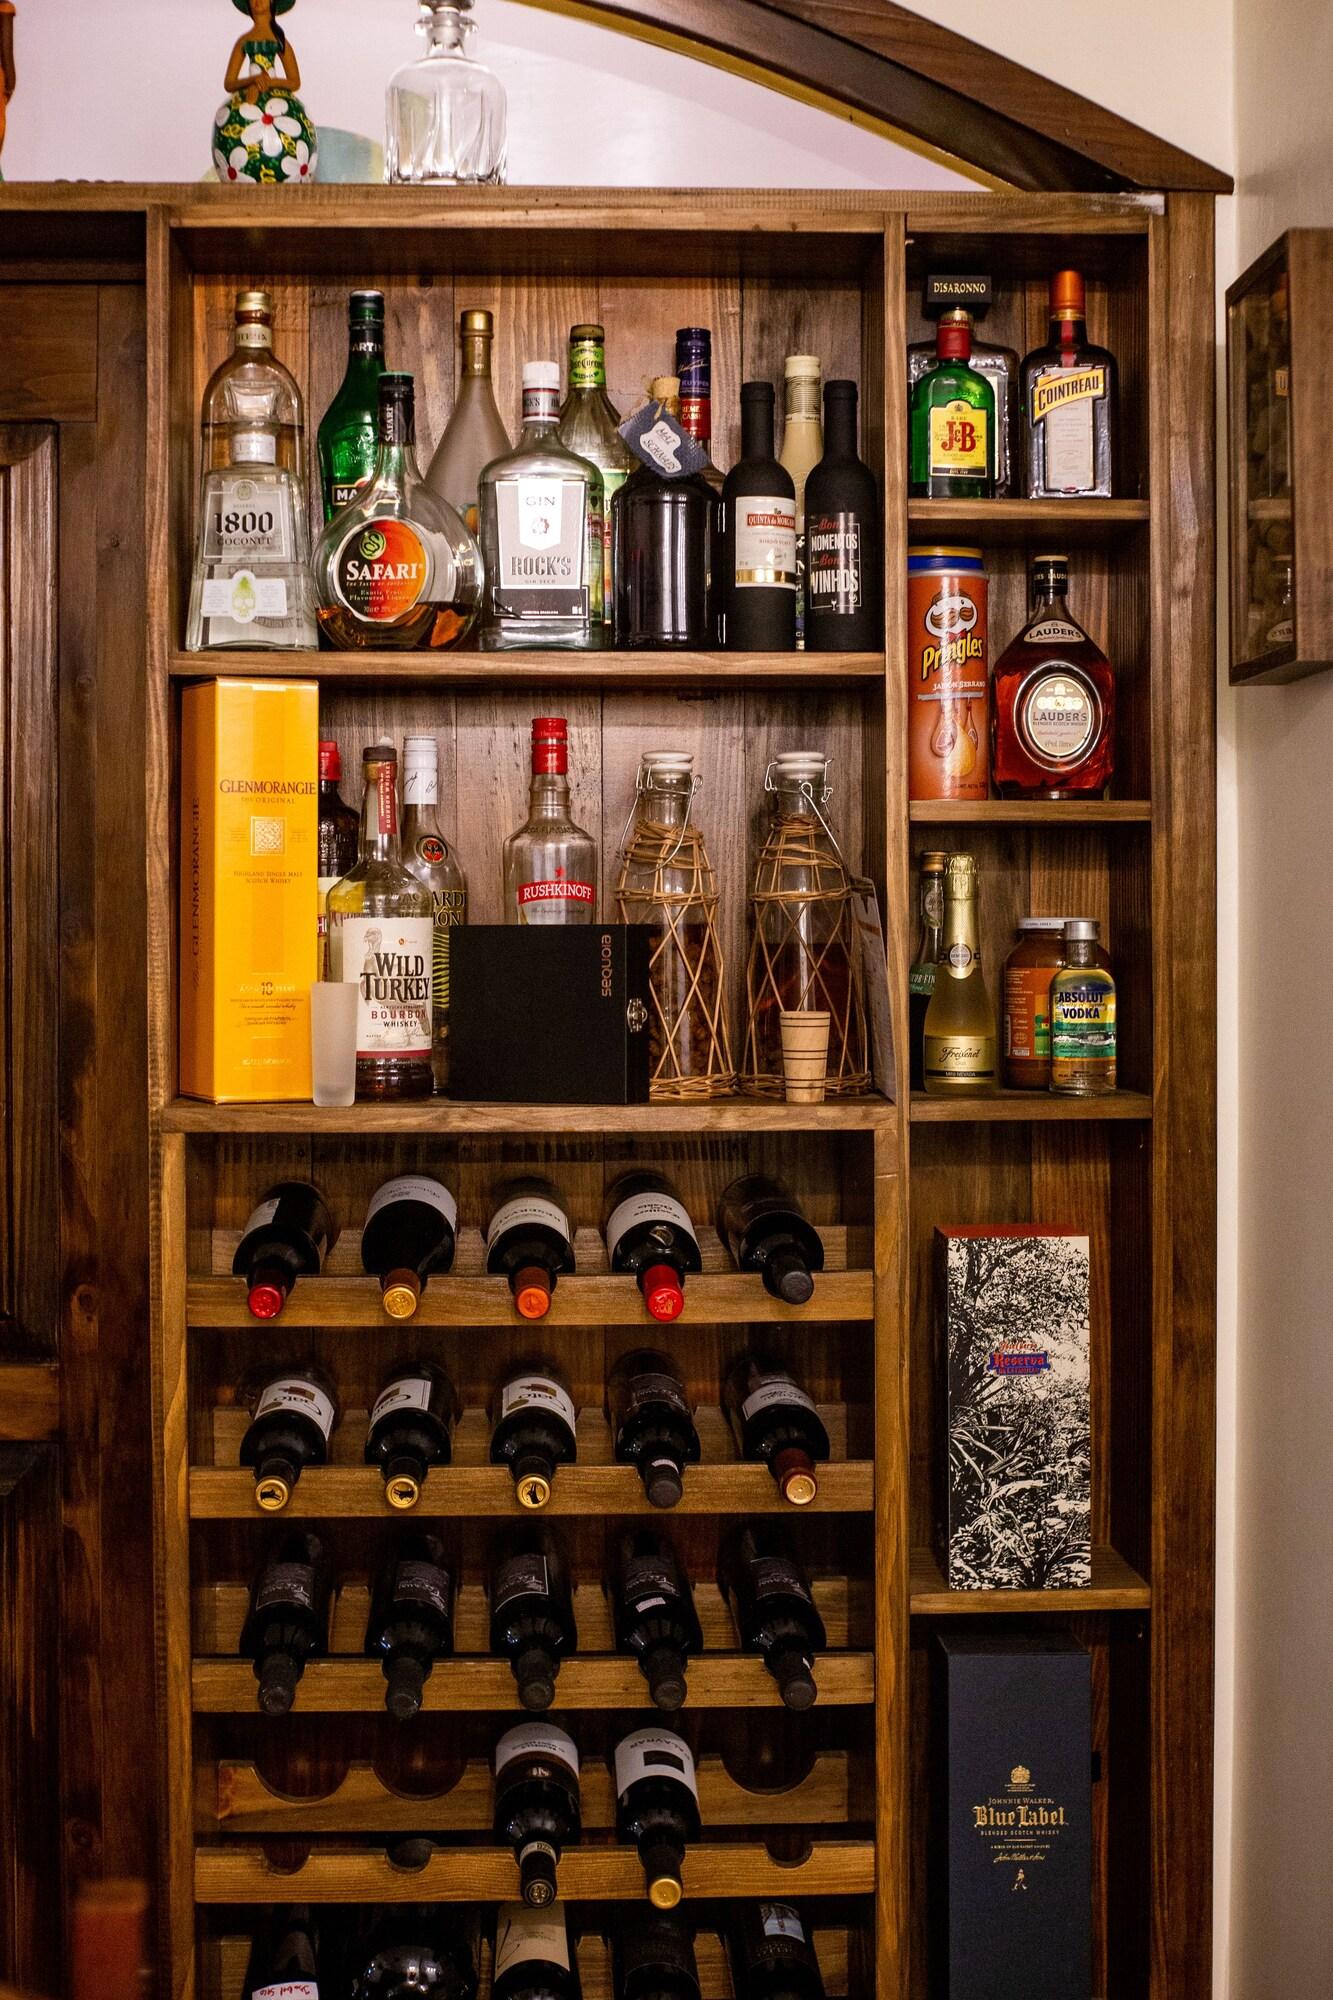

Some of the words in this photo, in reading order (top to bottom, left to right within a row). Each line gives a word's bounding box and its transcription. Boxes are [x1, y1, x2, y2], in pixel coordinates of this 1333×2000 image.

[933, 282, 986, 294] DISARONNO
[1038, 375, 1099, 412] COINTREAU
[385, 404, 394, 442] SAFARI
[941, 421, 976, 453] J&B
[525, 496, 556, 507] GIN
[213, 511, 273, 536] 1800
[216, 536, 273, 546] COCONUT
[811, 533, 858, 551] MOMENTOS
[346, 561, 418, 580] SAFARI
[511, 556, 572, 576] ROCK'S
[810, 569, 859, 594] VINHOS
[1029, 627, 1081, 640] LAUDER'S
[922, 632, 983, 680] Pringles
[1033, 711, 1088, 721] LAUDER'S
[219, 780, 317, 794] GLENMORANGIE
[192, 798, 200, 957] GLENMORANGIE
[523, 883, 592, 900] RUSHKINOFF
[374, 952, 424, 977] WILD
[601, 934, 612, 997] sequoia
[360, 973, 430, 1003] TURKEY
[1058, 992, 1104, 1003] ABSOLUT
[371, 1010, 426, 1020] BOURBON
[1062, 1008, 1100, 1019] VODKA
[993, 1351, 1044, 1368] Reserva
[987, 1797, 1021, 1806] JOHNNIE
[972, 1805, 1016, 1828] Blue
[1016, 1805, 1065, 1828] Label
